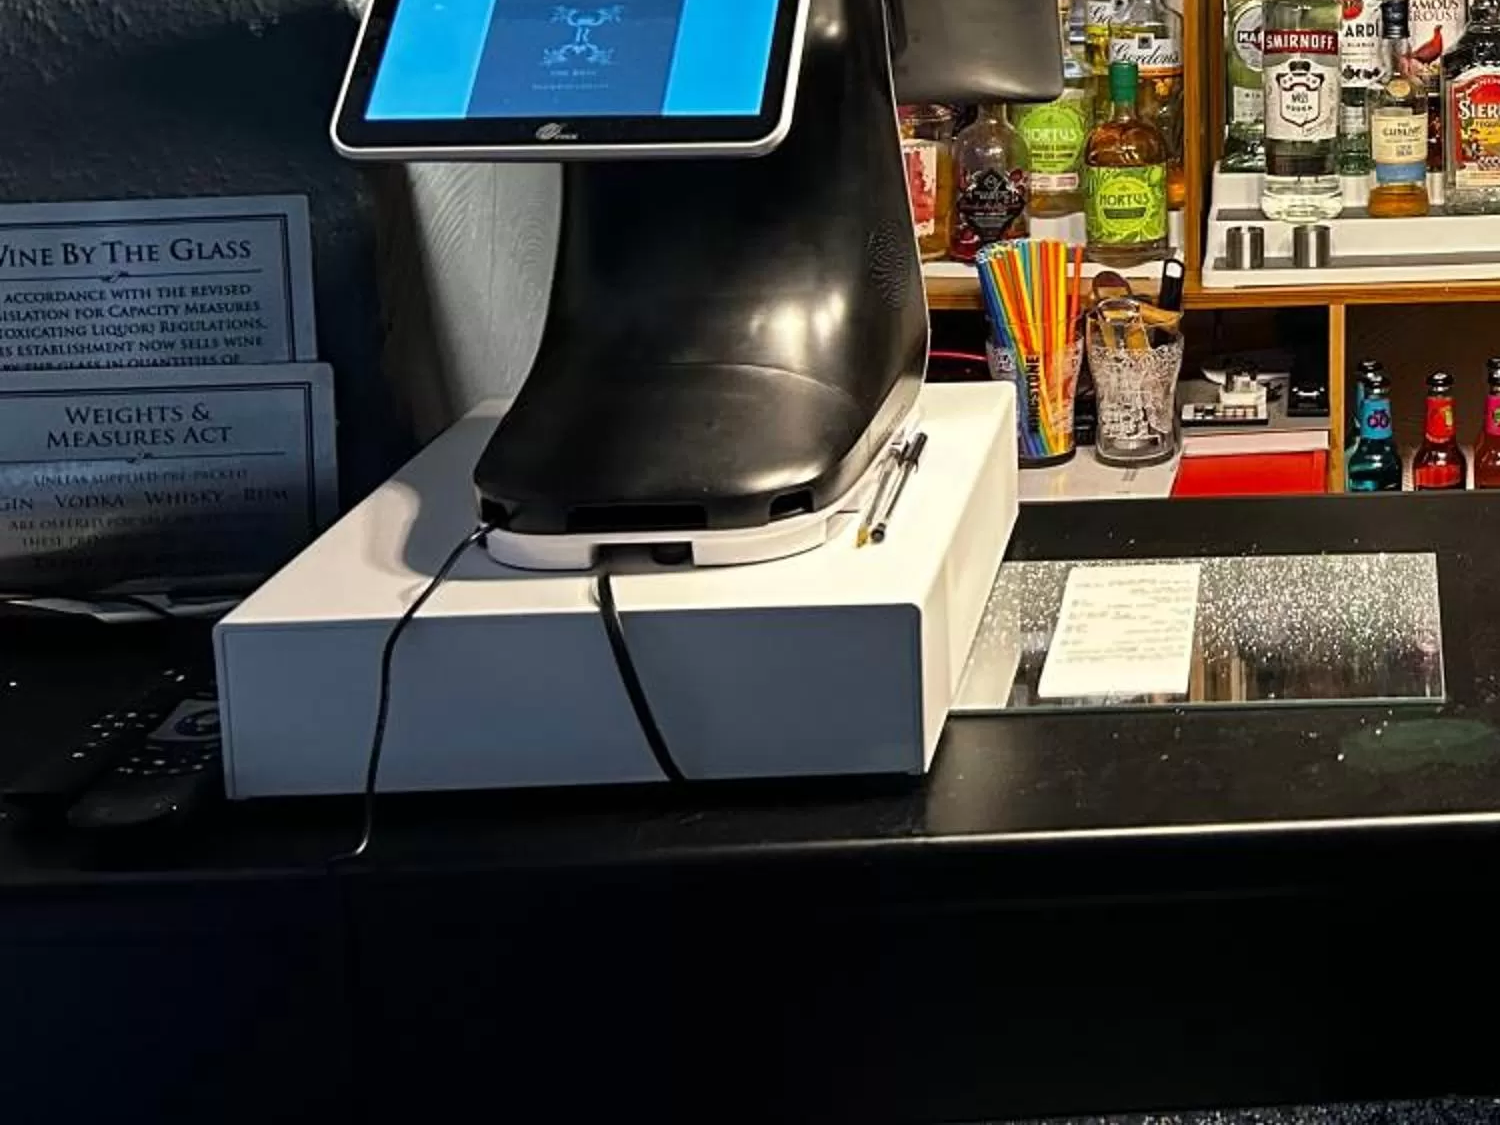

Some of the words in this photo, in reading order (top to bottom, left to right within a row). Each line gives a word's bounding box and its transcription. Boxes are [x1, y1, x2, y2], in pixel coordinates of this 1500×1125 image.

[1345, 23, 1380, 37] ARDI
[1266, 34, 1335, 50] SMIRNOFF
[1100, 194, 1150, 207] HORTUS
[3, 290, 106, 304] ACCORDANCE
[111, 287, 152, 301] WITH
[157, 286, 186, 299] THE
[191, 284, 252, 297] REVISED
[0, 308, 69, 322] ISLATION
[75, 306, 104, 320] FOR
[0, 325, 87, 339] OXICATING
[17, 341, 134, 356] ESTABLISHMENT
[139, 338, 176, 351] NOW
[180, 337, 219, 350] SELLS
[223, 335, 262, 347] WINE
[191, 403, 210, 421] &
